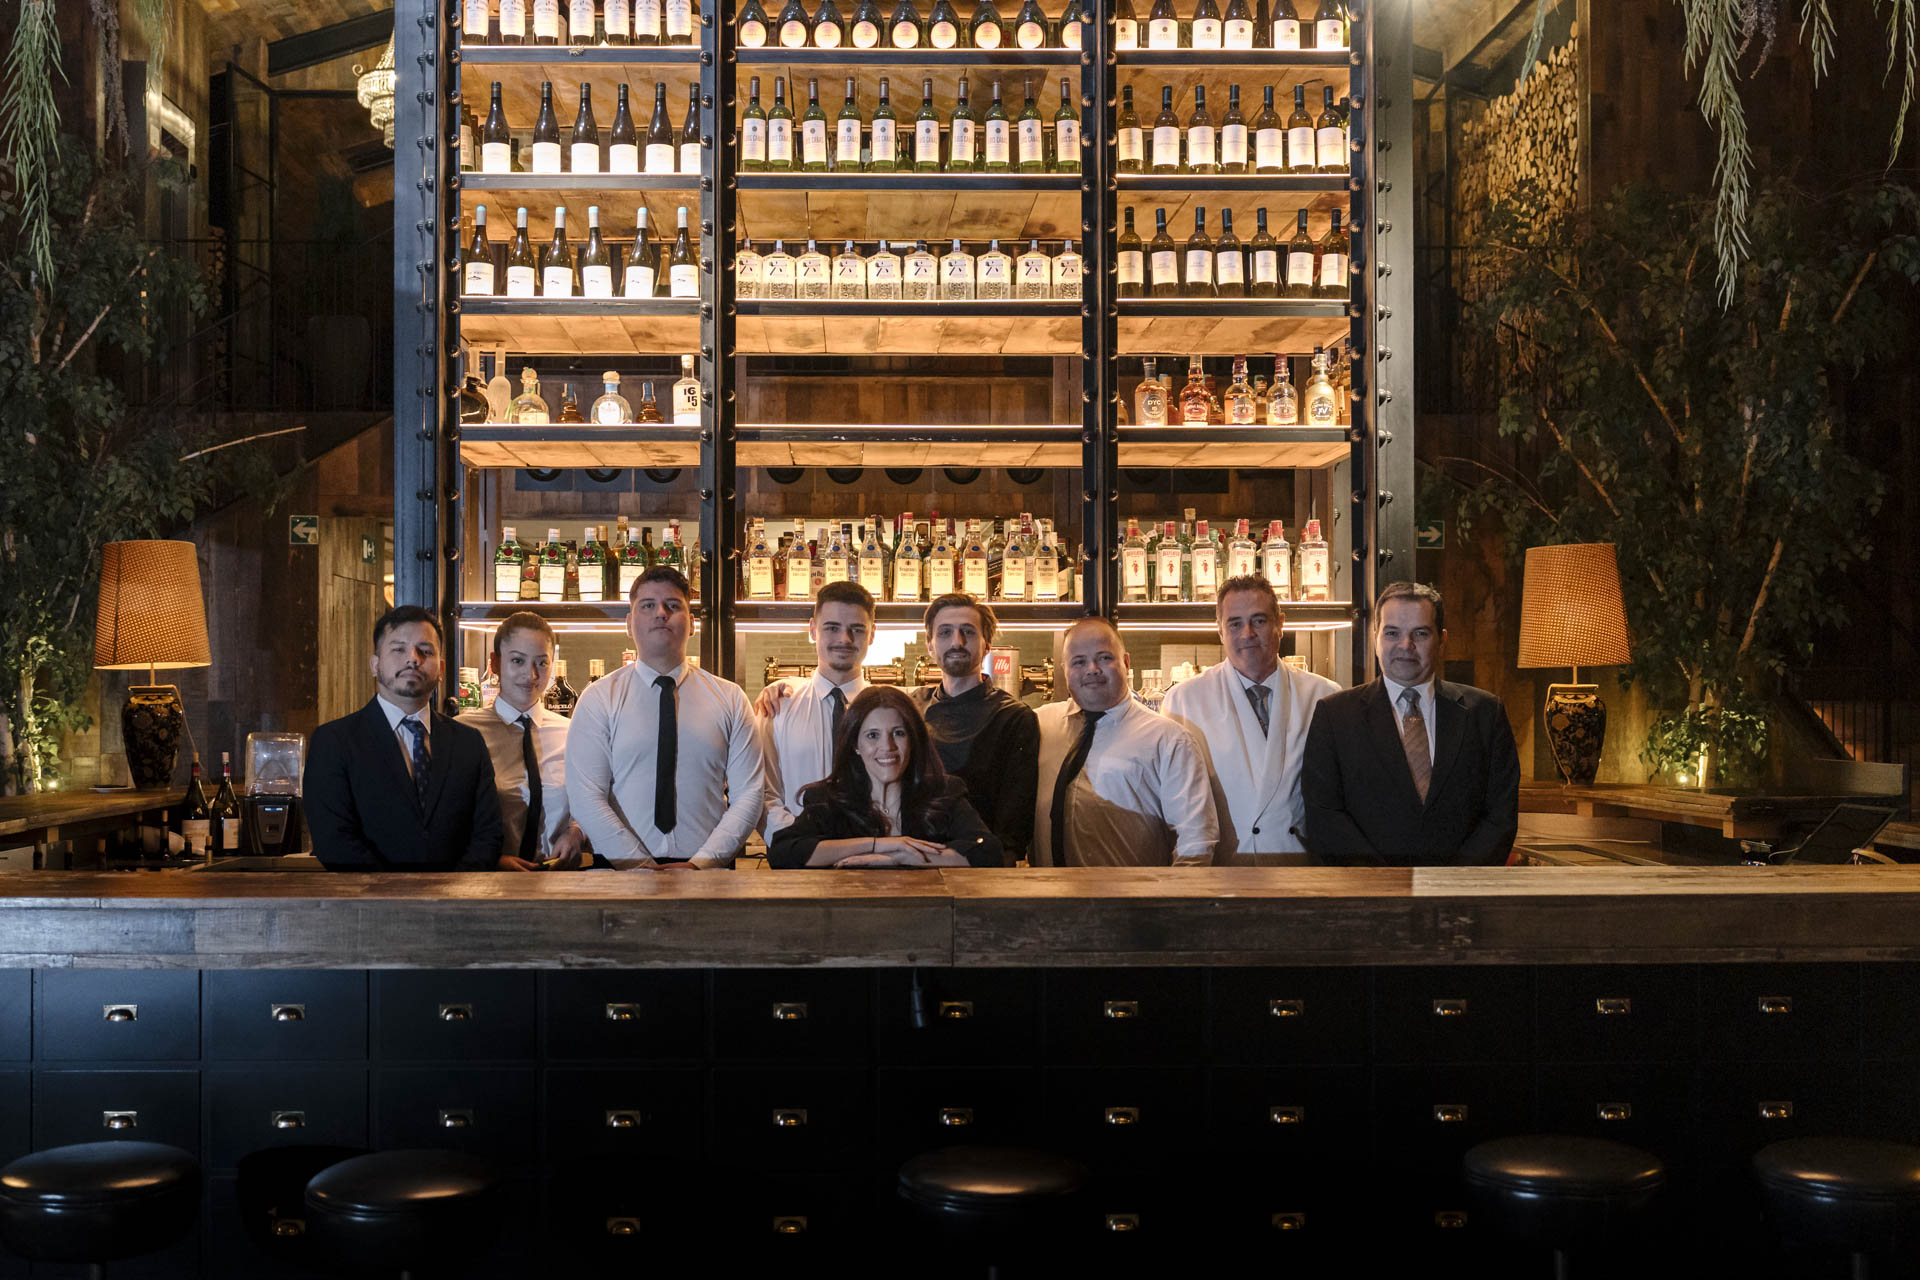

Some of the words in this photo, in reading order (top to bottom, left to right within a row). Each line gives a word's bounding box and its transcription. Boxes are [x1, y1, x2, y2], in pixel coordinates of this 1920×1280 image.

[684, 387, 696, 395] 16
[687, 396, 698, 407] 15
[995, 658, 1010, 673] illy
